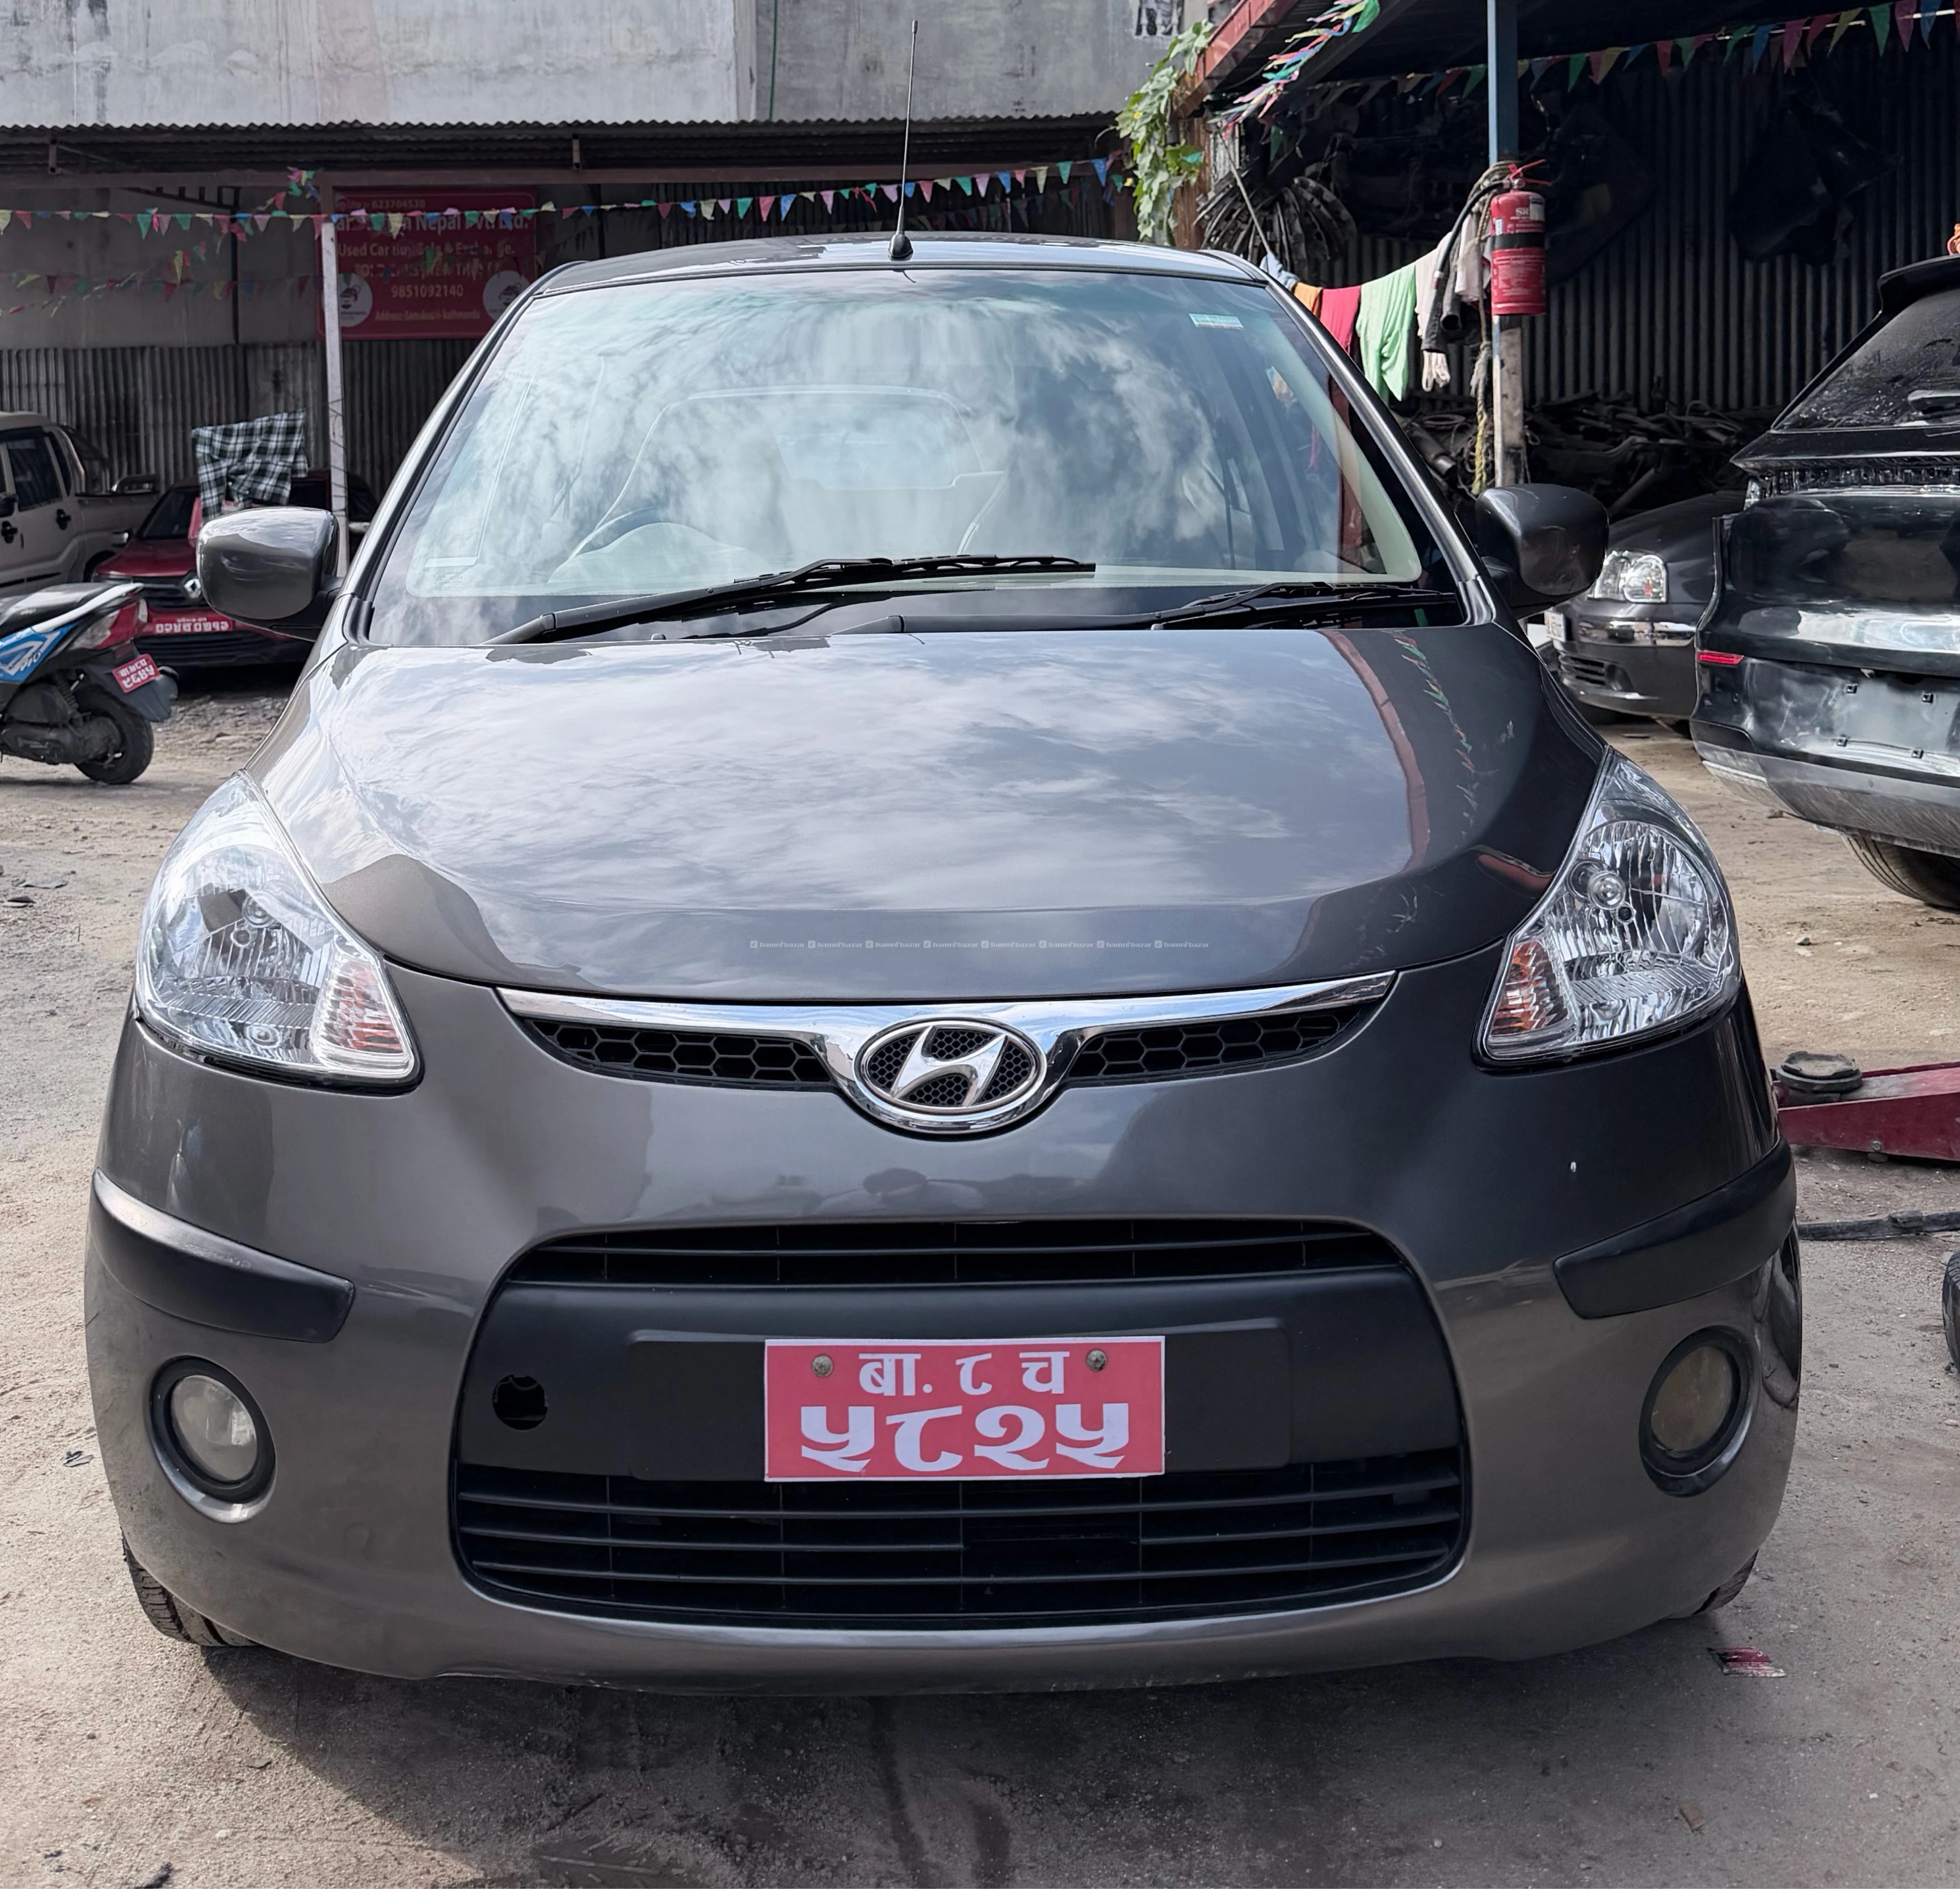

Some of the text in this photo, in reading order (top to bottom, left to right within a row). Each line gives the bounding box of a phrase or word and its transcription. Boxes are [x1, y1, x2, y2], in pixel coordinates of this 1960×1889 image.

[337, 242, 366, 257] Used
[369, 243, 389, 257] Car
[390, 284, 464, 298] 9851092140
[859, 1352, 933, 1396] बा.
[1019, 1351, 1070, 1394] च
[801, 1402, 1129, 1472] ५८२५
